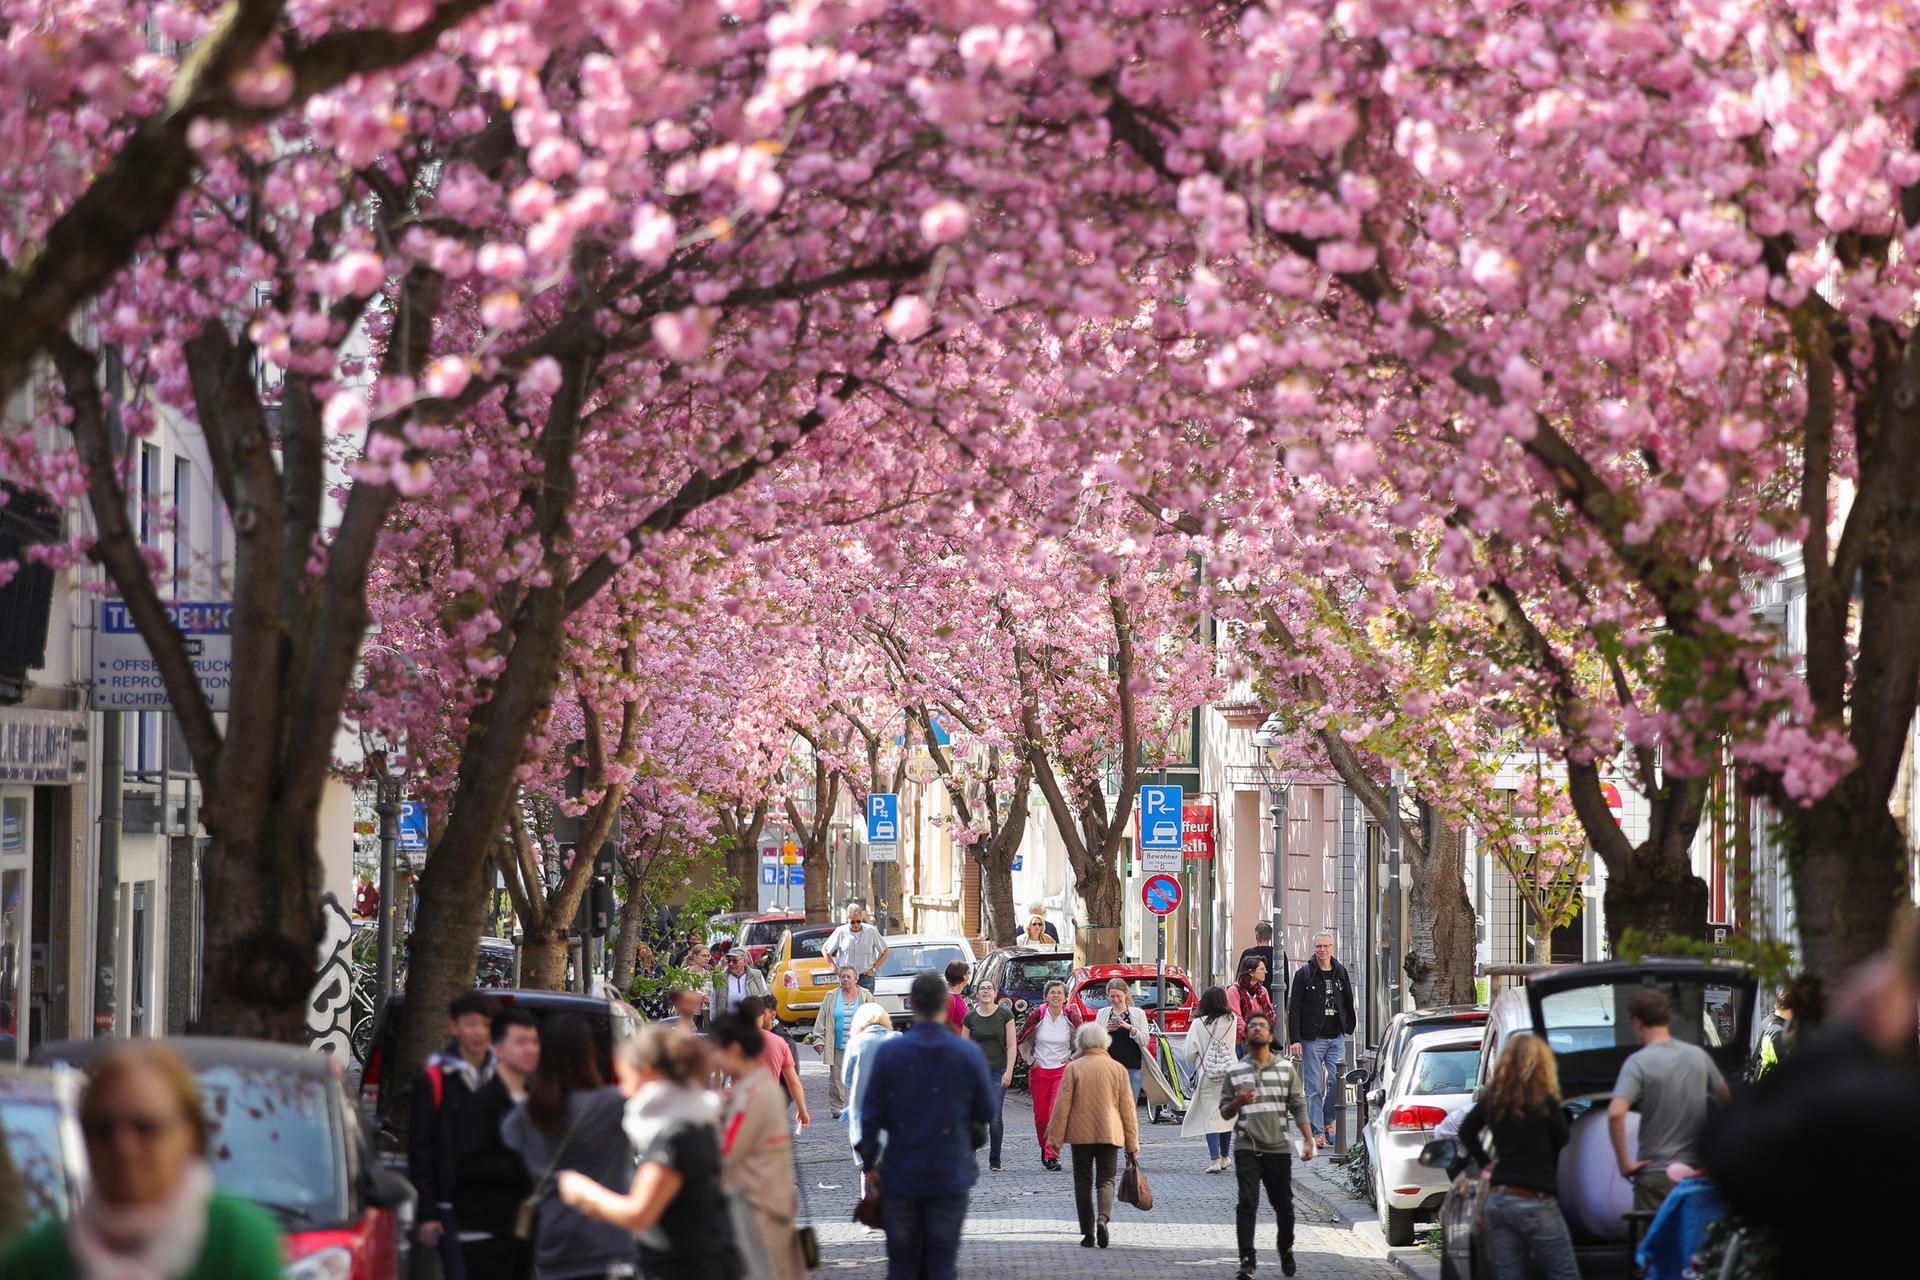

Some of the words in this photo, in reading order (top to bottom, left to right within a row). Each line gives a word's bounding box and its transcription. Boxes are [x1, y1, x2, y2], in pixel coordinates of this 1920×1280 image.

[108, 607, 234, 629] TEPELHO
[112, 660, 233, 672] OFFSERUCK
[112, 677, 232, 688] REPROTION
[112, 693, 215, 705] LICHTPAN
[872, 797, 886, 817] P
[1147, 790, 1165, 815] P
[400, 804, 414, 824] P
[1182, 821, 1209, 833] ffeur
